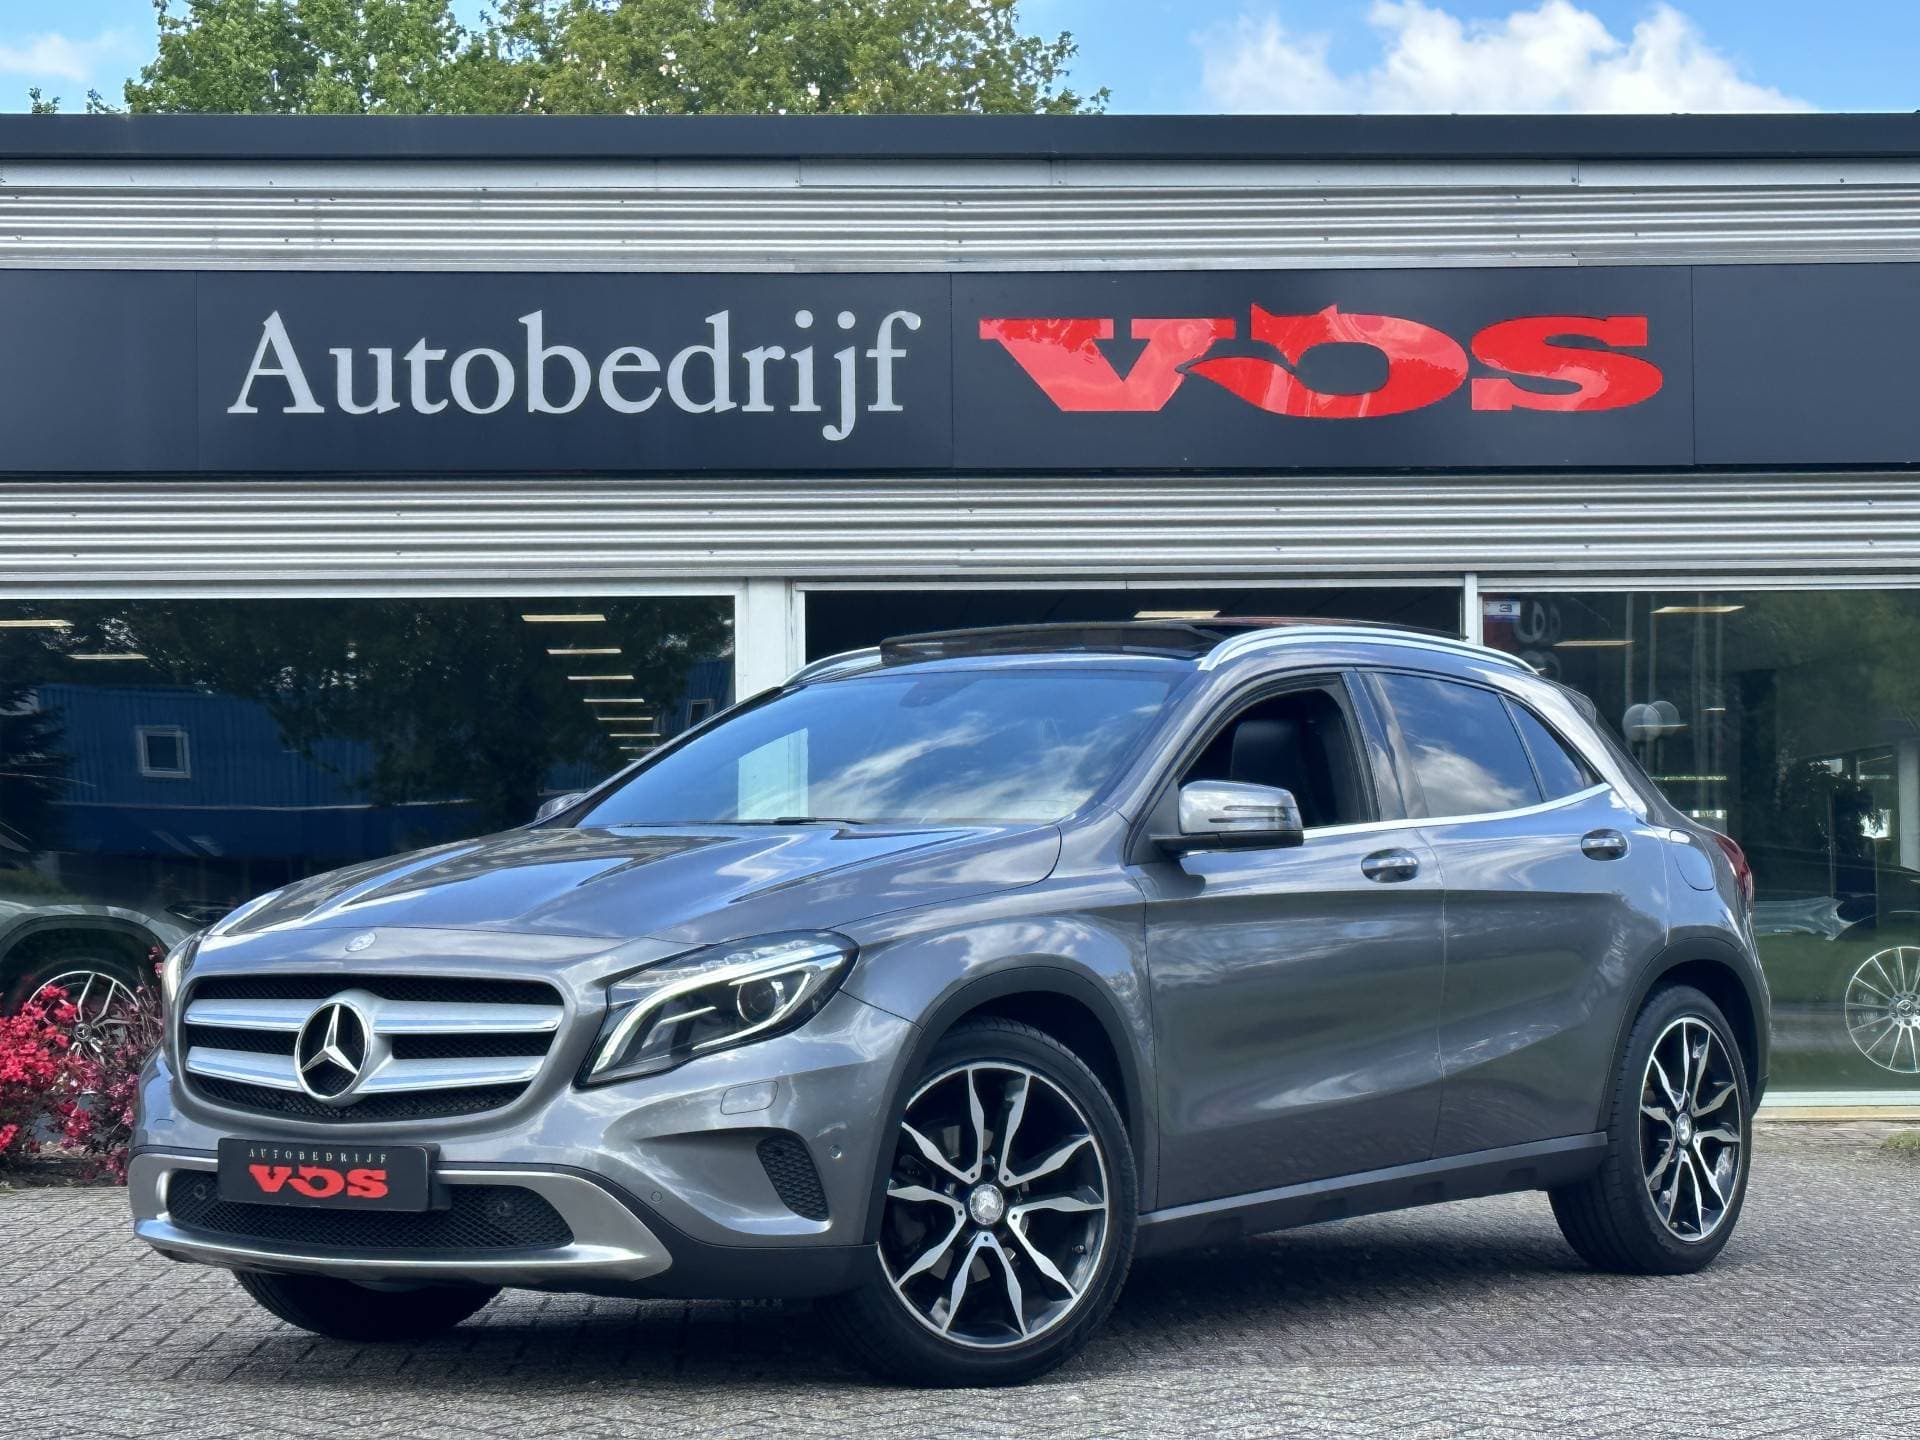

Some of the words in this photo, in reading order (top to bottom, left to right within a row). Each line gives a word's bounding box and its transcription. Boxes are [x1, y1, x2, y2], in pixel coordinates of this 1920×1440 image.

[227, 309, 922, 442] Autobedrijf
[979, 303, 1664, 419] VOS
[249, 1148, 387, 1164] AUTOBEDRIJF
[248, 1163, 389, 1199] VOS
